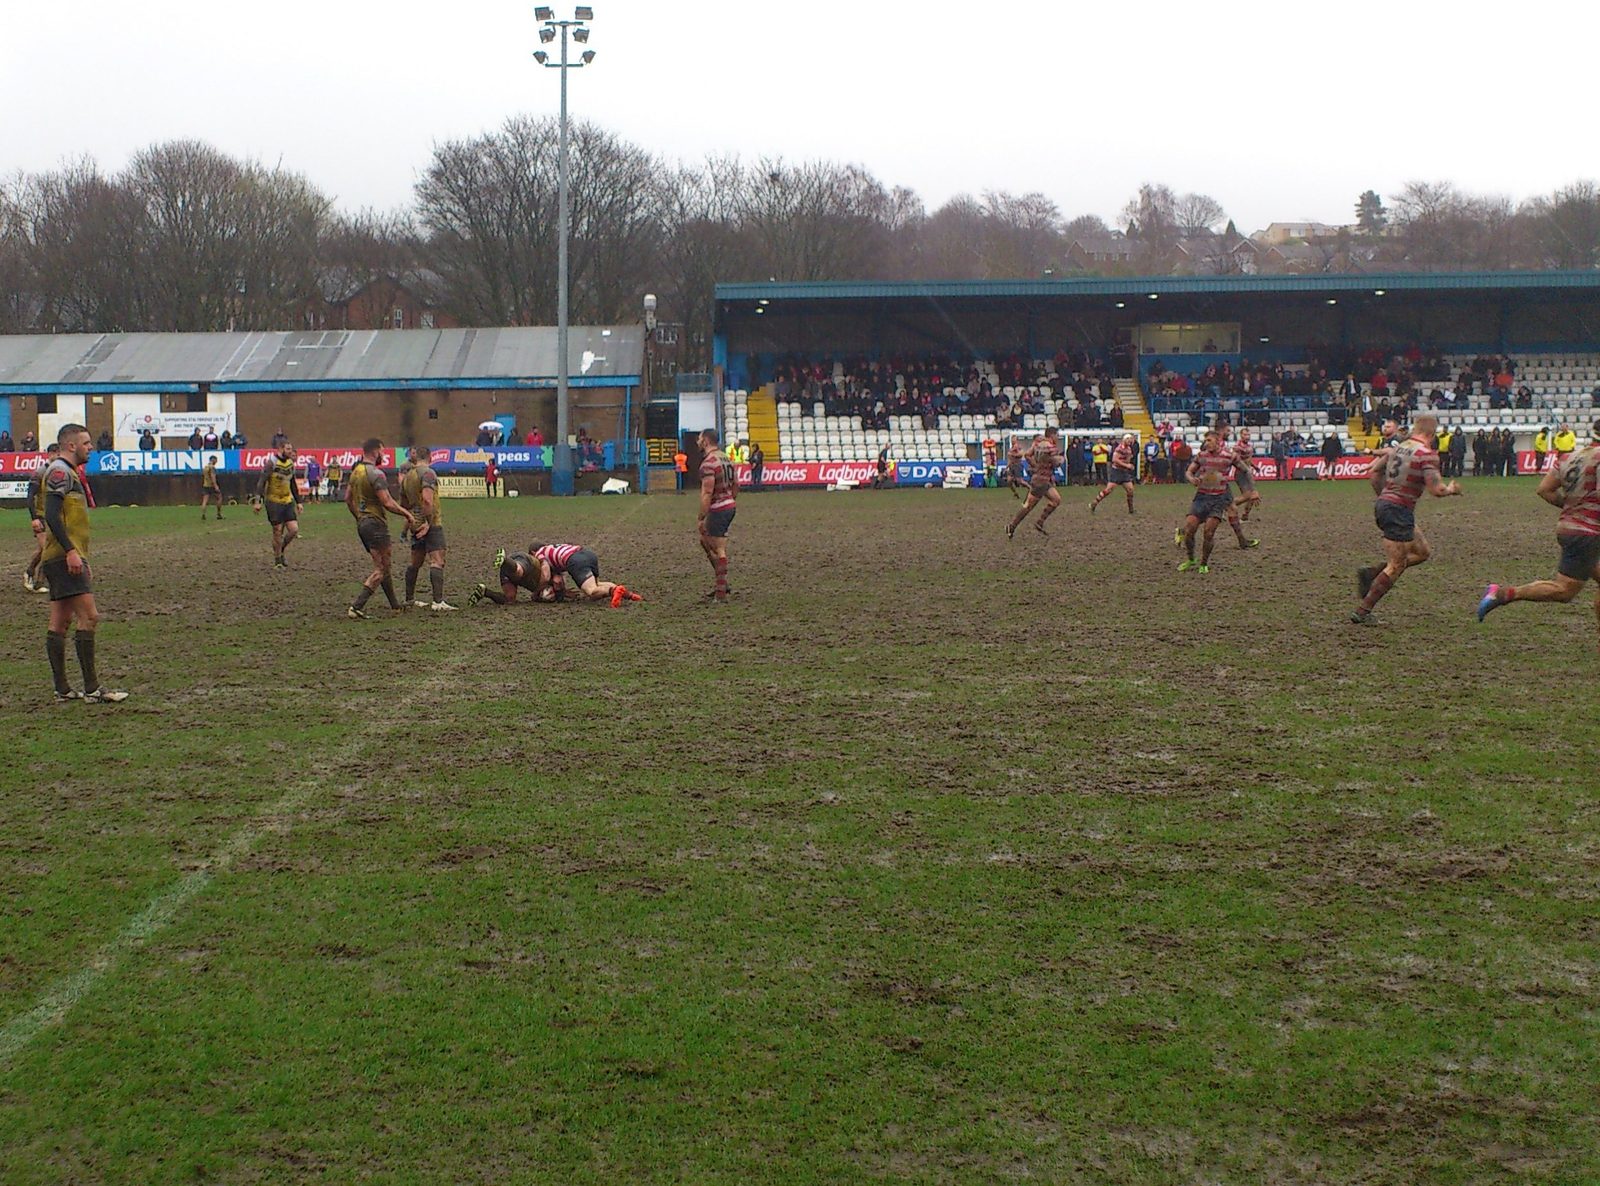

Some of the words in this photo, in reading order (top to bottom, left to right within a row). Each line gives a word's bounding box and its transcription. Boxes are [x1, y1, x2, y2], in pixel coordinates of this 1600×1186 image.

[121, 452, 225, 470] RHINO
[498, 451, 530, 464] peas
[722, 464, 735, 483] 10
[737, 466, 807, 481] Labrokes
[1389, 456, 1403, 478] 3
